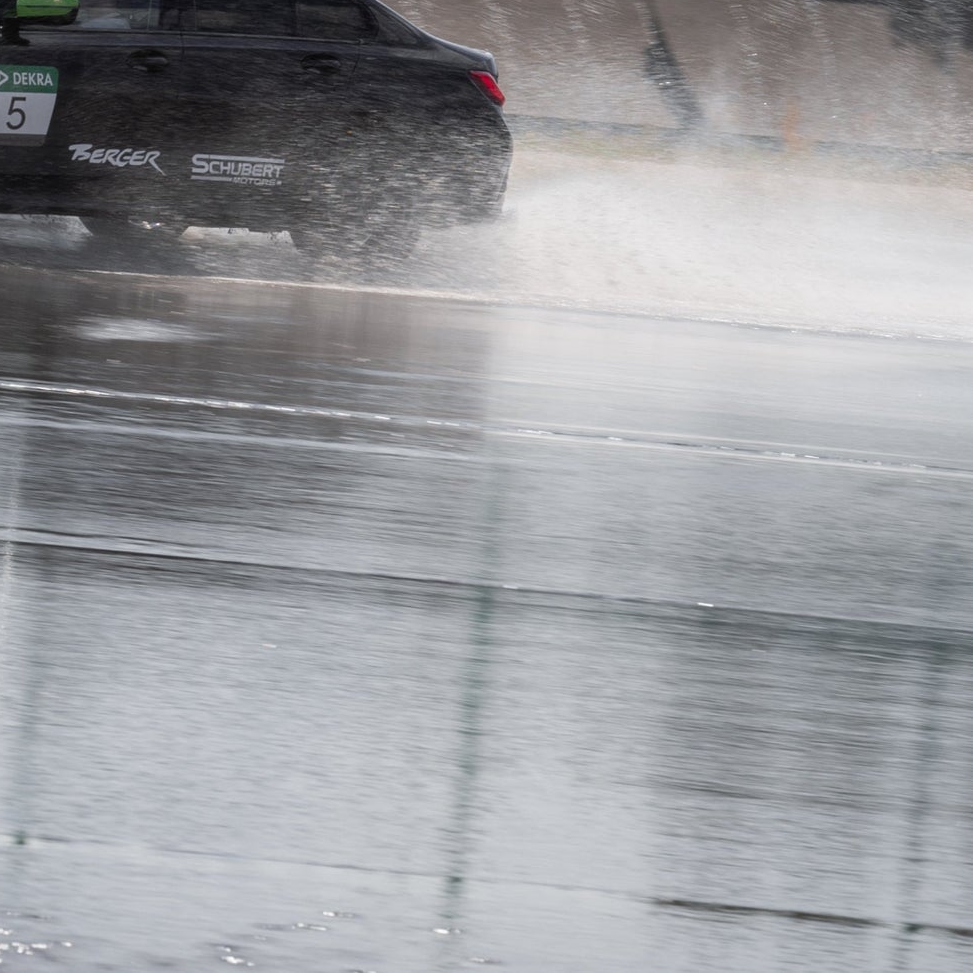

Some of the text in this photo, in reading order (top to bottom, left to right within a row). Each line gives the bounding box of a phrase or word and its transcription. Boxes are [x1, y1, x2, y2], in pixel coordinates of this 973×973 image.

[12, 71, 53, 87] DEKRA
[6, 97, 26, 130] 5
[191, 153, 285, 178] SCHUBERT
